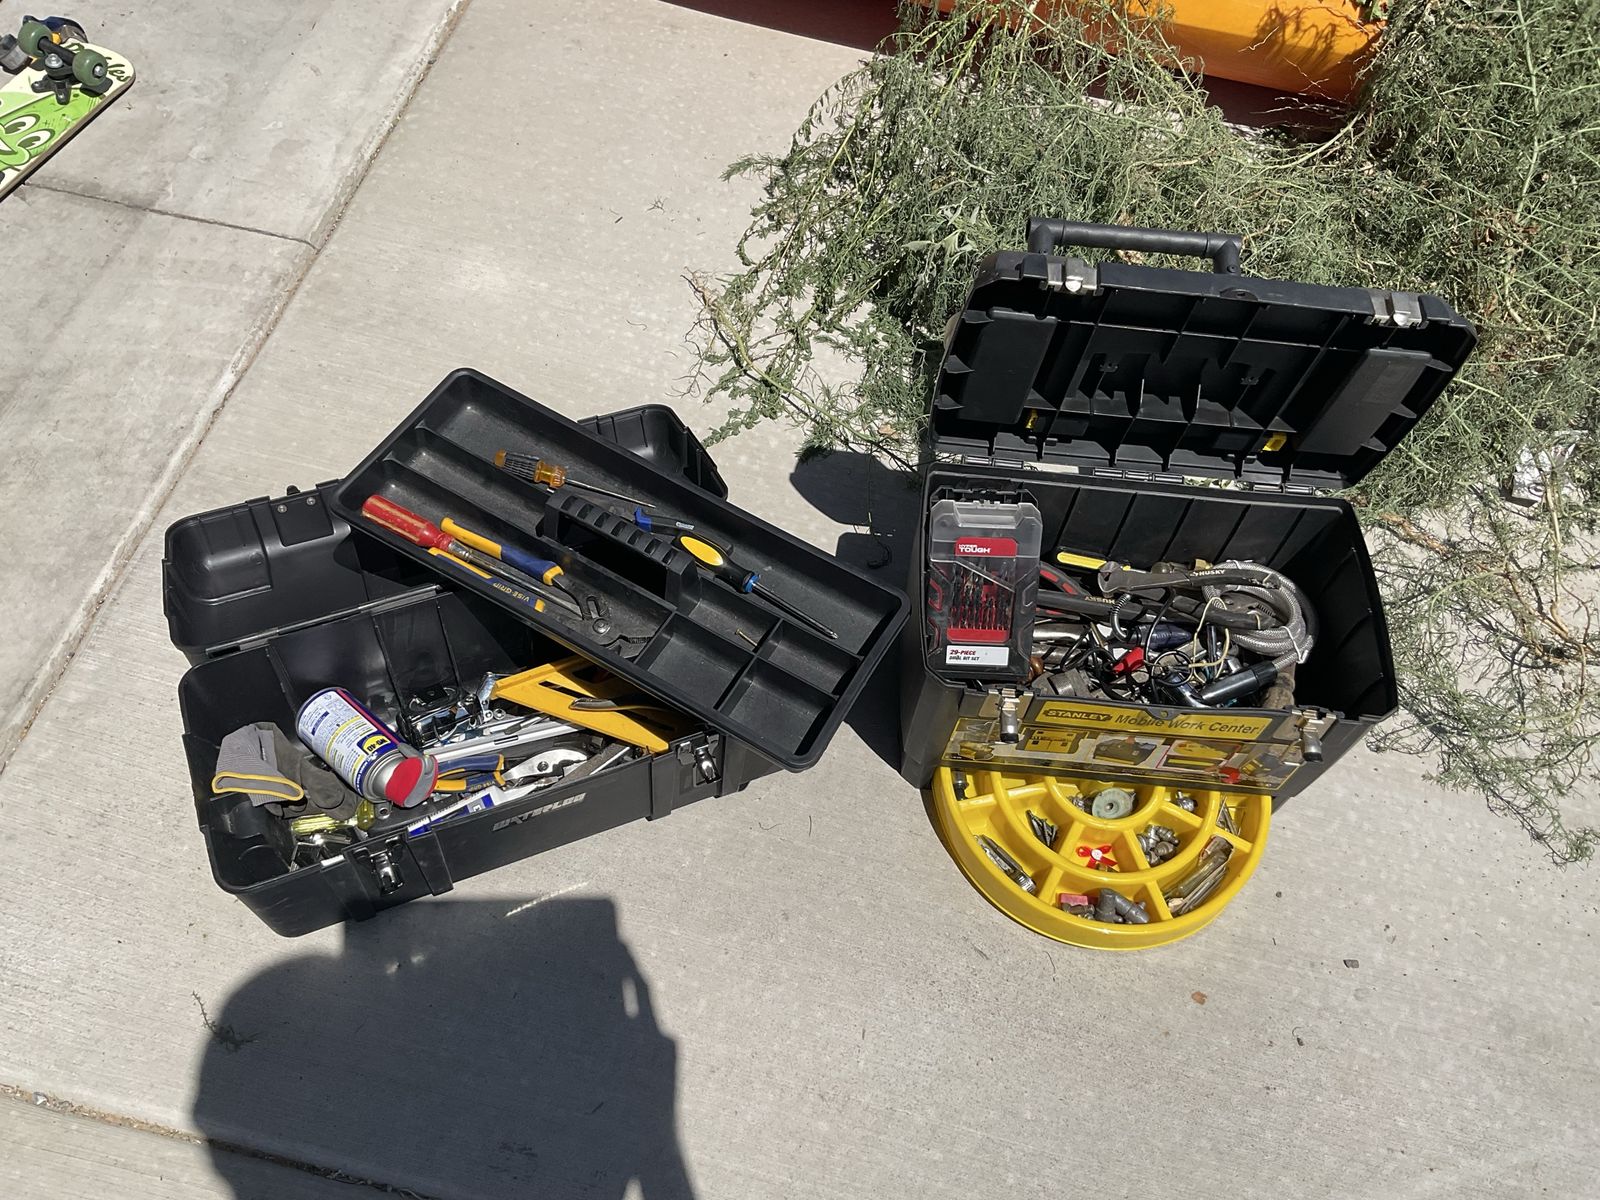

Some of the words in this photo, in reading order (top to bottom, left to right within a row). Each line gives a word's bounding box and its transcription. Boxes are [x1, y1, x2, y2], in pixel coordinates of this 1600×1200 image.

[1047, 709, 1109, 721] STANLEY
[1115, 714, 1165, 727] Mobile
[1168, 719, 1204, 731] Work
[1208, 721, 1260, 734] Center
[367, 738, 389, 752] WD-40
